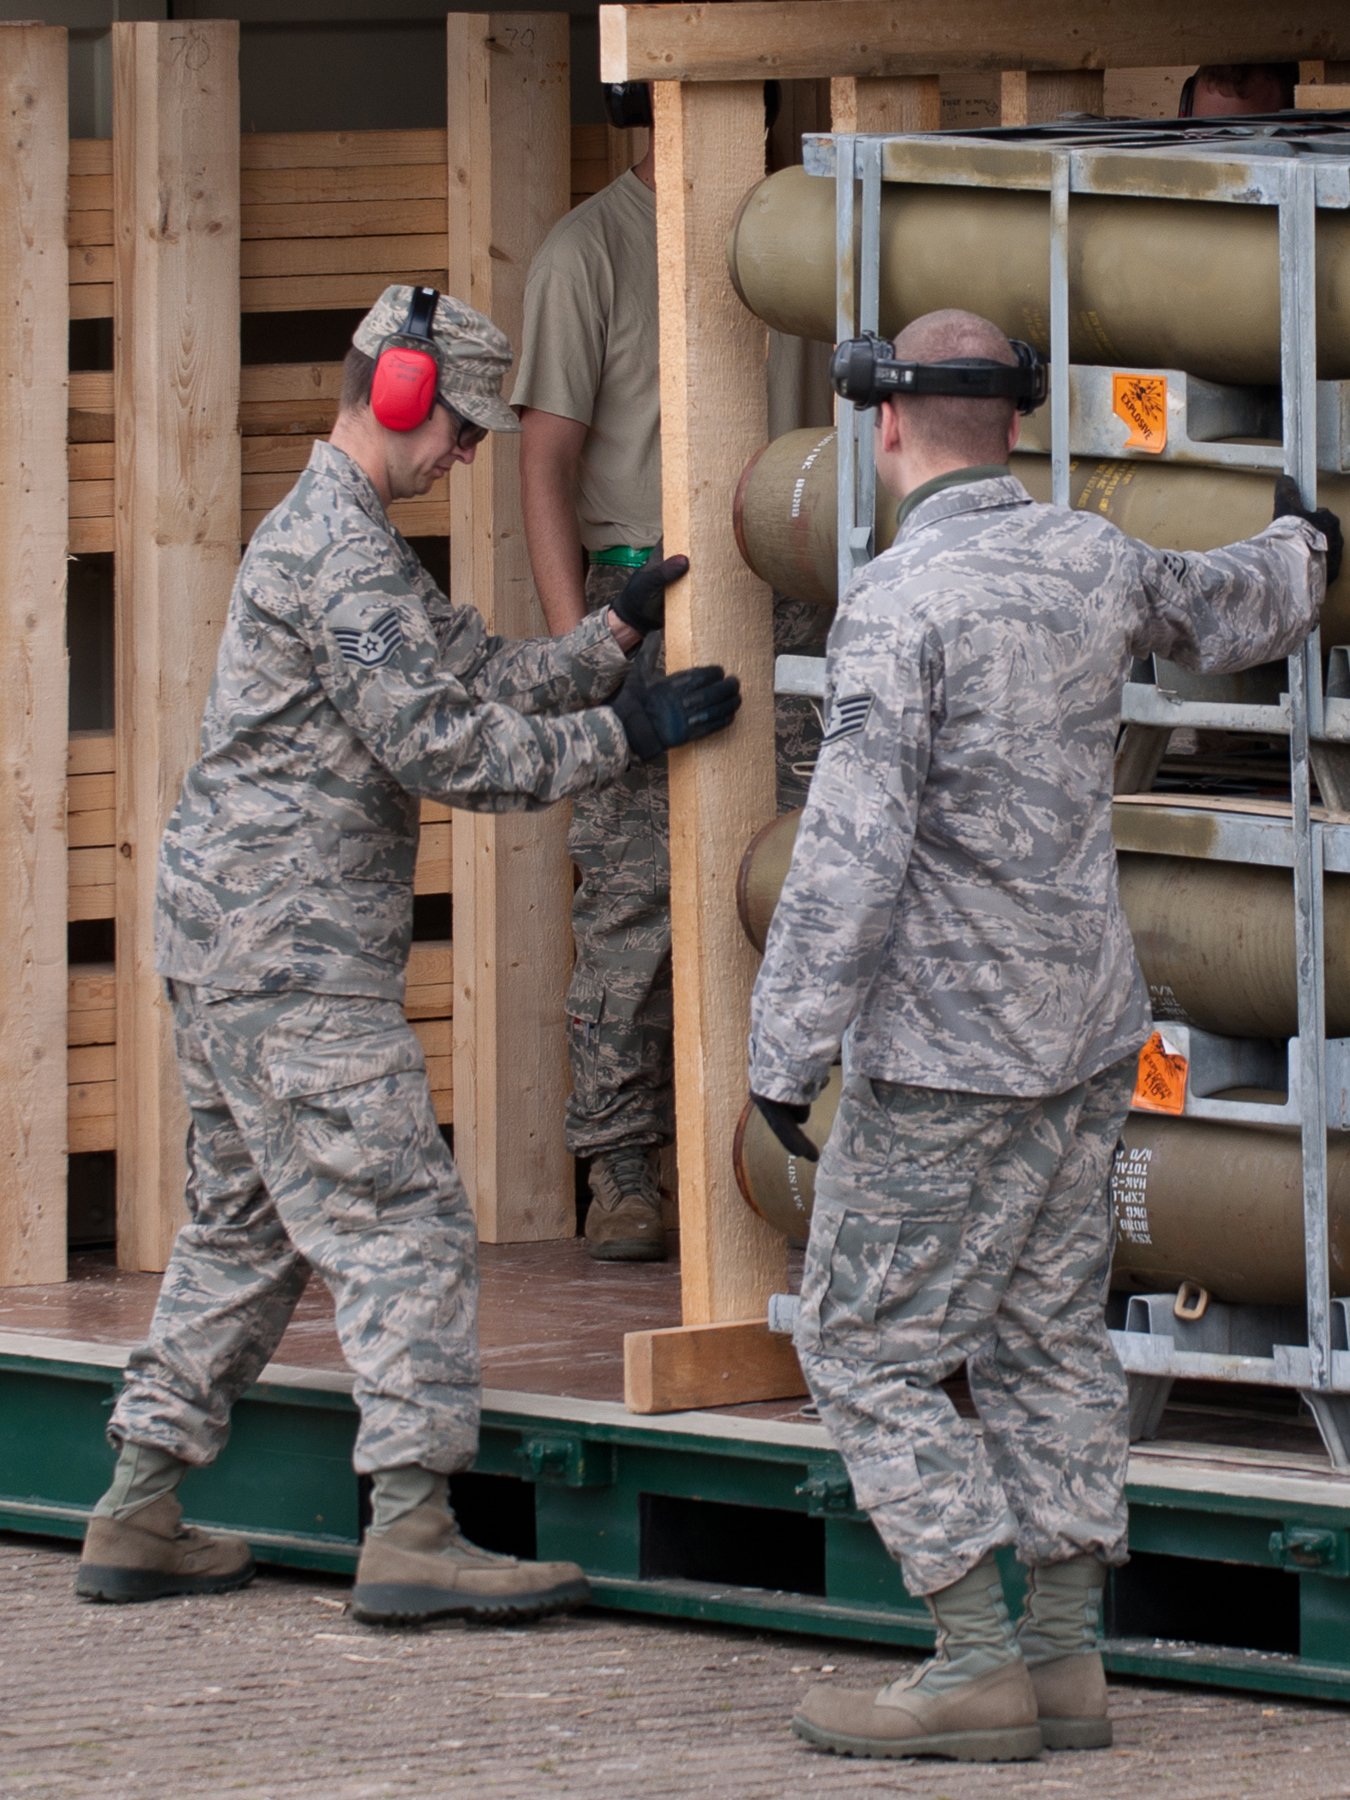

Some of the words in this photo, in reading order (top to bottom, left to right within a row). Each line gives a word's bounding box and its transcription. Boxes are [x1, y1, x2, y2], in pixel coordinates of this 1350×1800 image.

[1120, 392, 1153, 441] EXPLOSIVE
[1115, 1162, 1148, 1175] TOTAL
[1120, 1218, 1149, 1232] BOMB
